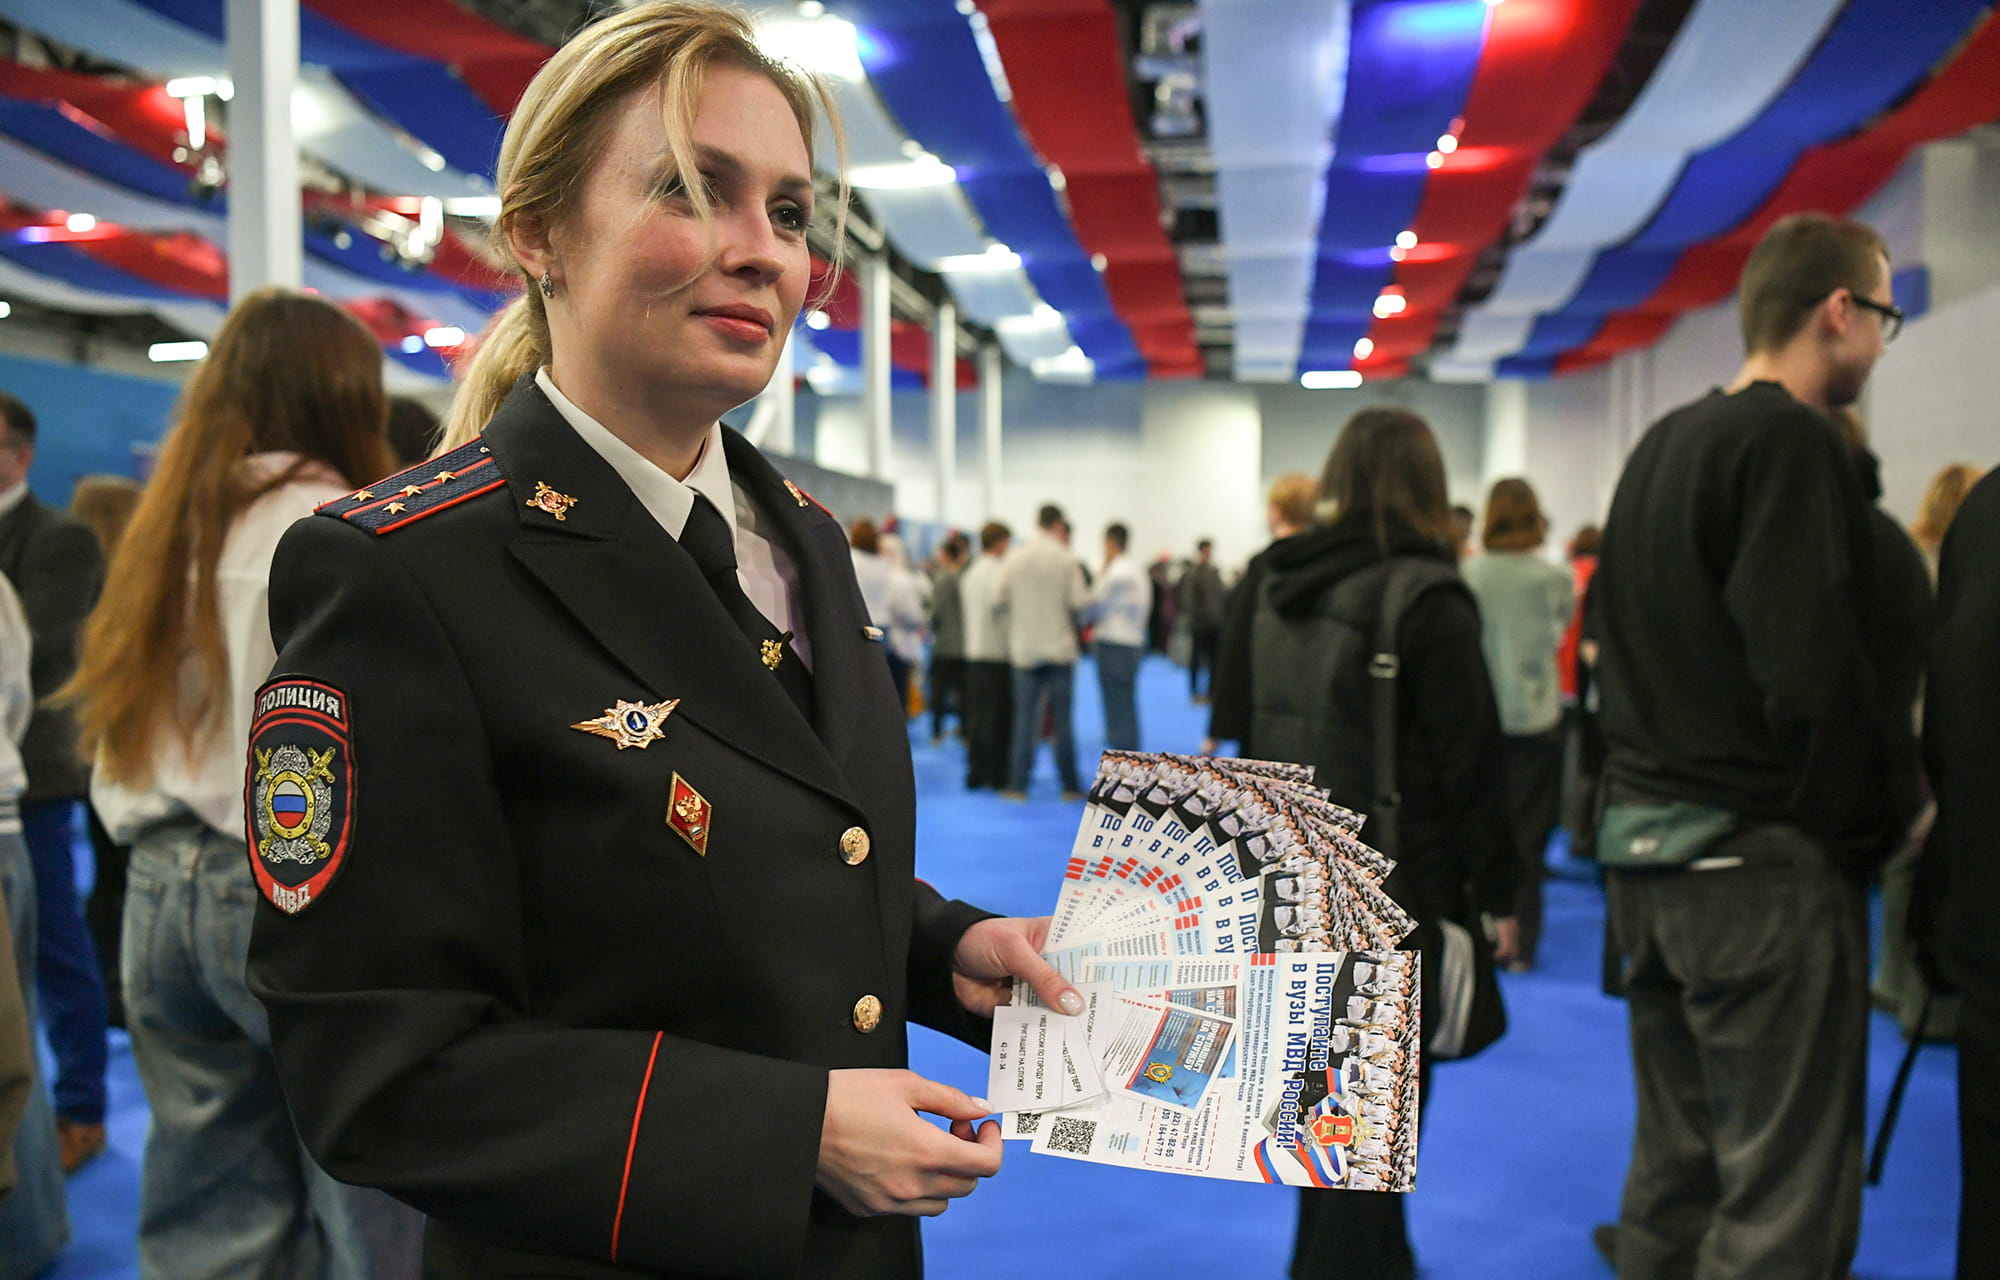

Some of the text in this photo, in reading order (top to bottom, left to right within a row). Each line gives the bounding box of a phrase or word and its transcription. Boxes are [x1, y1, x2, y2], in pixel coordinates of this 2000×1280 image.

[259, 687, 340, 719] ПОЛИЦИЯ
[272, 882, 311, 914] МВД
[1089, 992, 1097, 1009] УМВД
[1310, 963, 1335, 1070] Поступайте
[1088, 1010, 1096, 1033] РОССИИ
[1200, 1020, 1212, 1032] НА
[1038, 1048, 1044, 1056] ПО
[1184, 1034, 1206, 1071] СЛУЖБУ
[1192, 1022, 1220, 1074] ПРИГЛАШАЕТ
[1277, 963, 1307, 1150] в вузы МВД России!
[1017, 1066, 1025, 1091] СЛУЖБУ
[1036, 1057, 1044, 1080] ГОРОДУ
[1064, 1055, 1076, 1075] ГОРОДУ
[1072, 1074, 1082, 1092] ТВЕРИ
